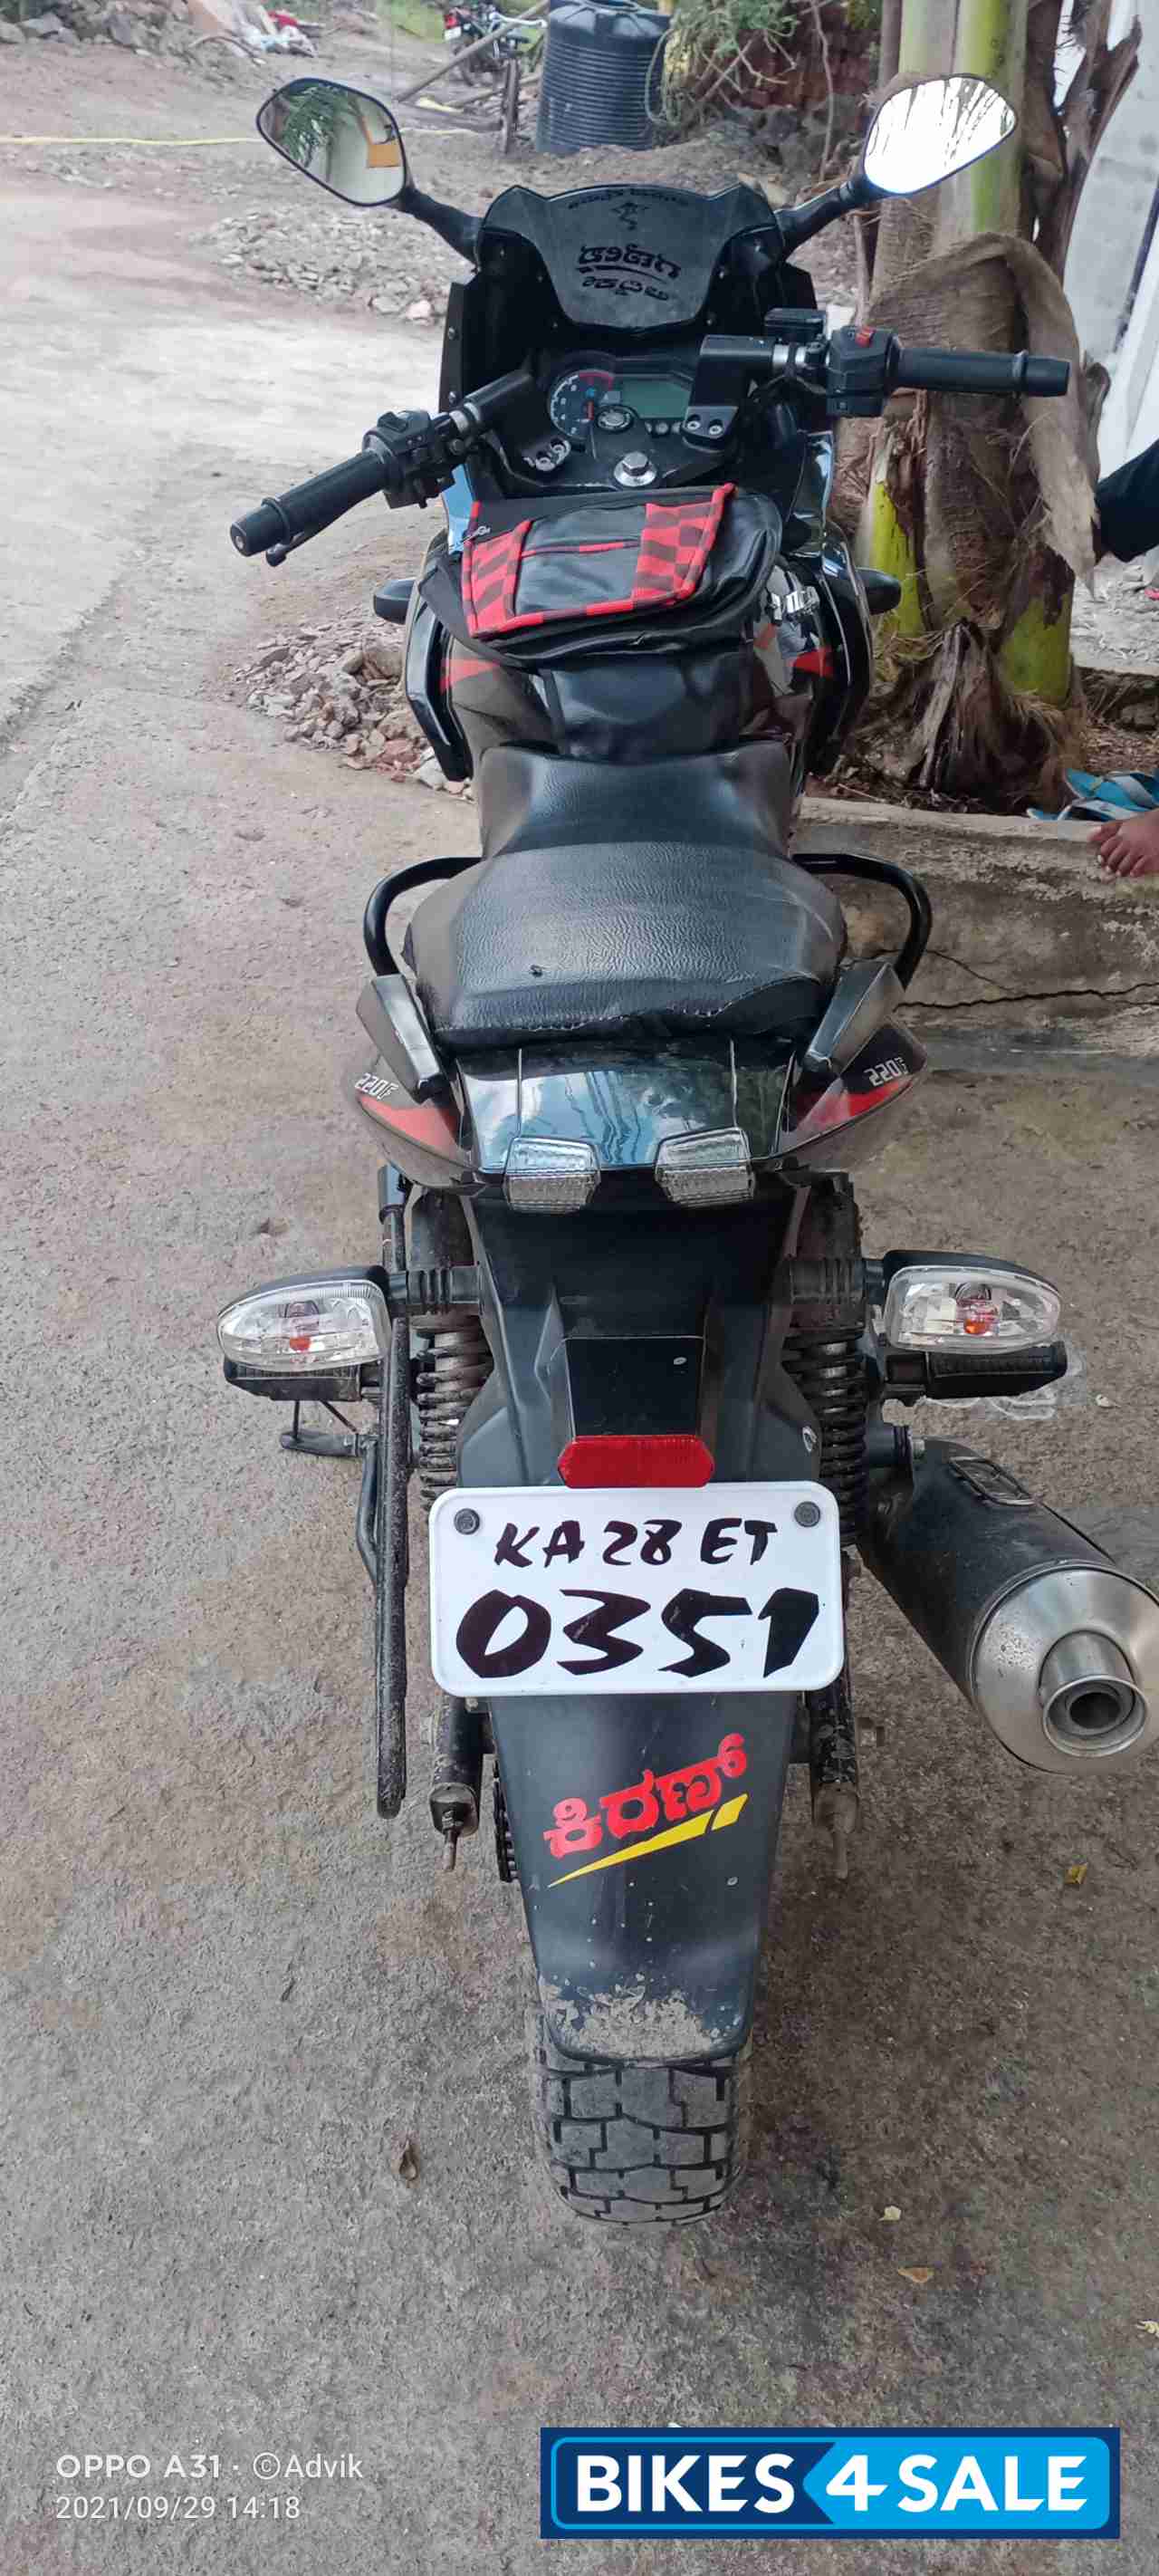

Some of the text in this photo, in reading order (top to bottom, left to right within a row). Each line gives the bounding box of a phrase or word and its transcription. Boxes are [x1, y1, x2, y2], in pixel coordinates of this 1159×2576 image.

[493, 1517, 778, 1568] KA 28 ET
[455, 1586, 820, 1679] 0351
